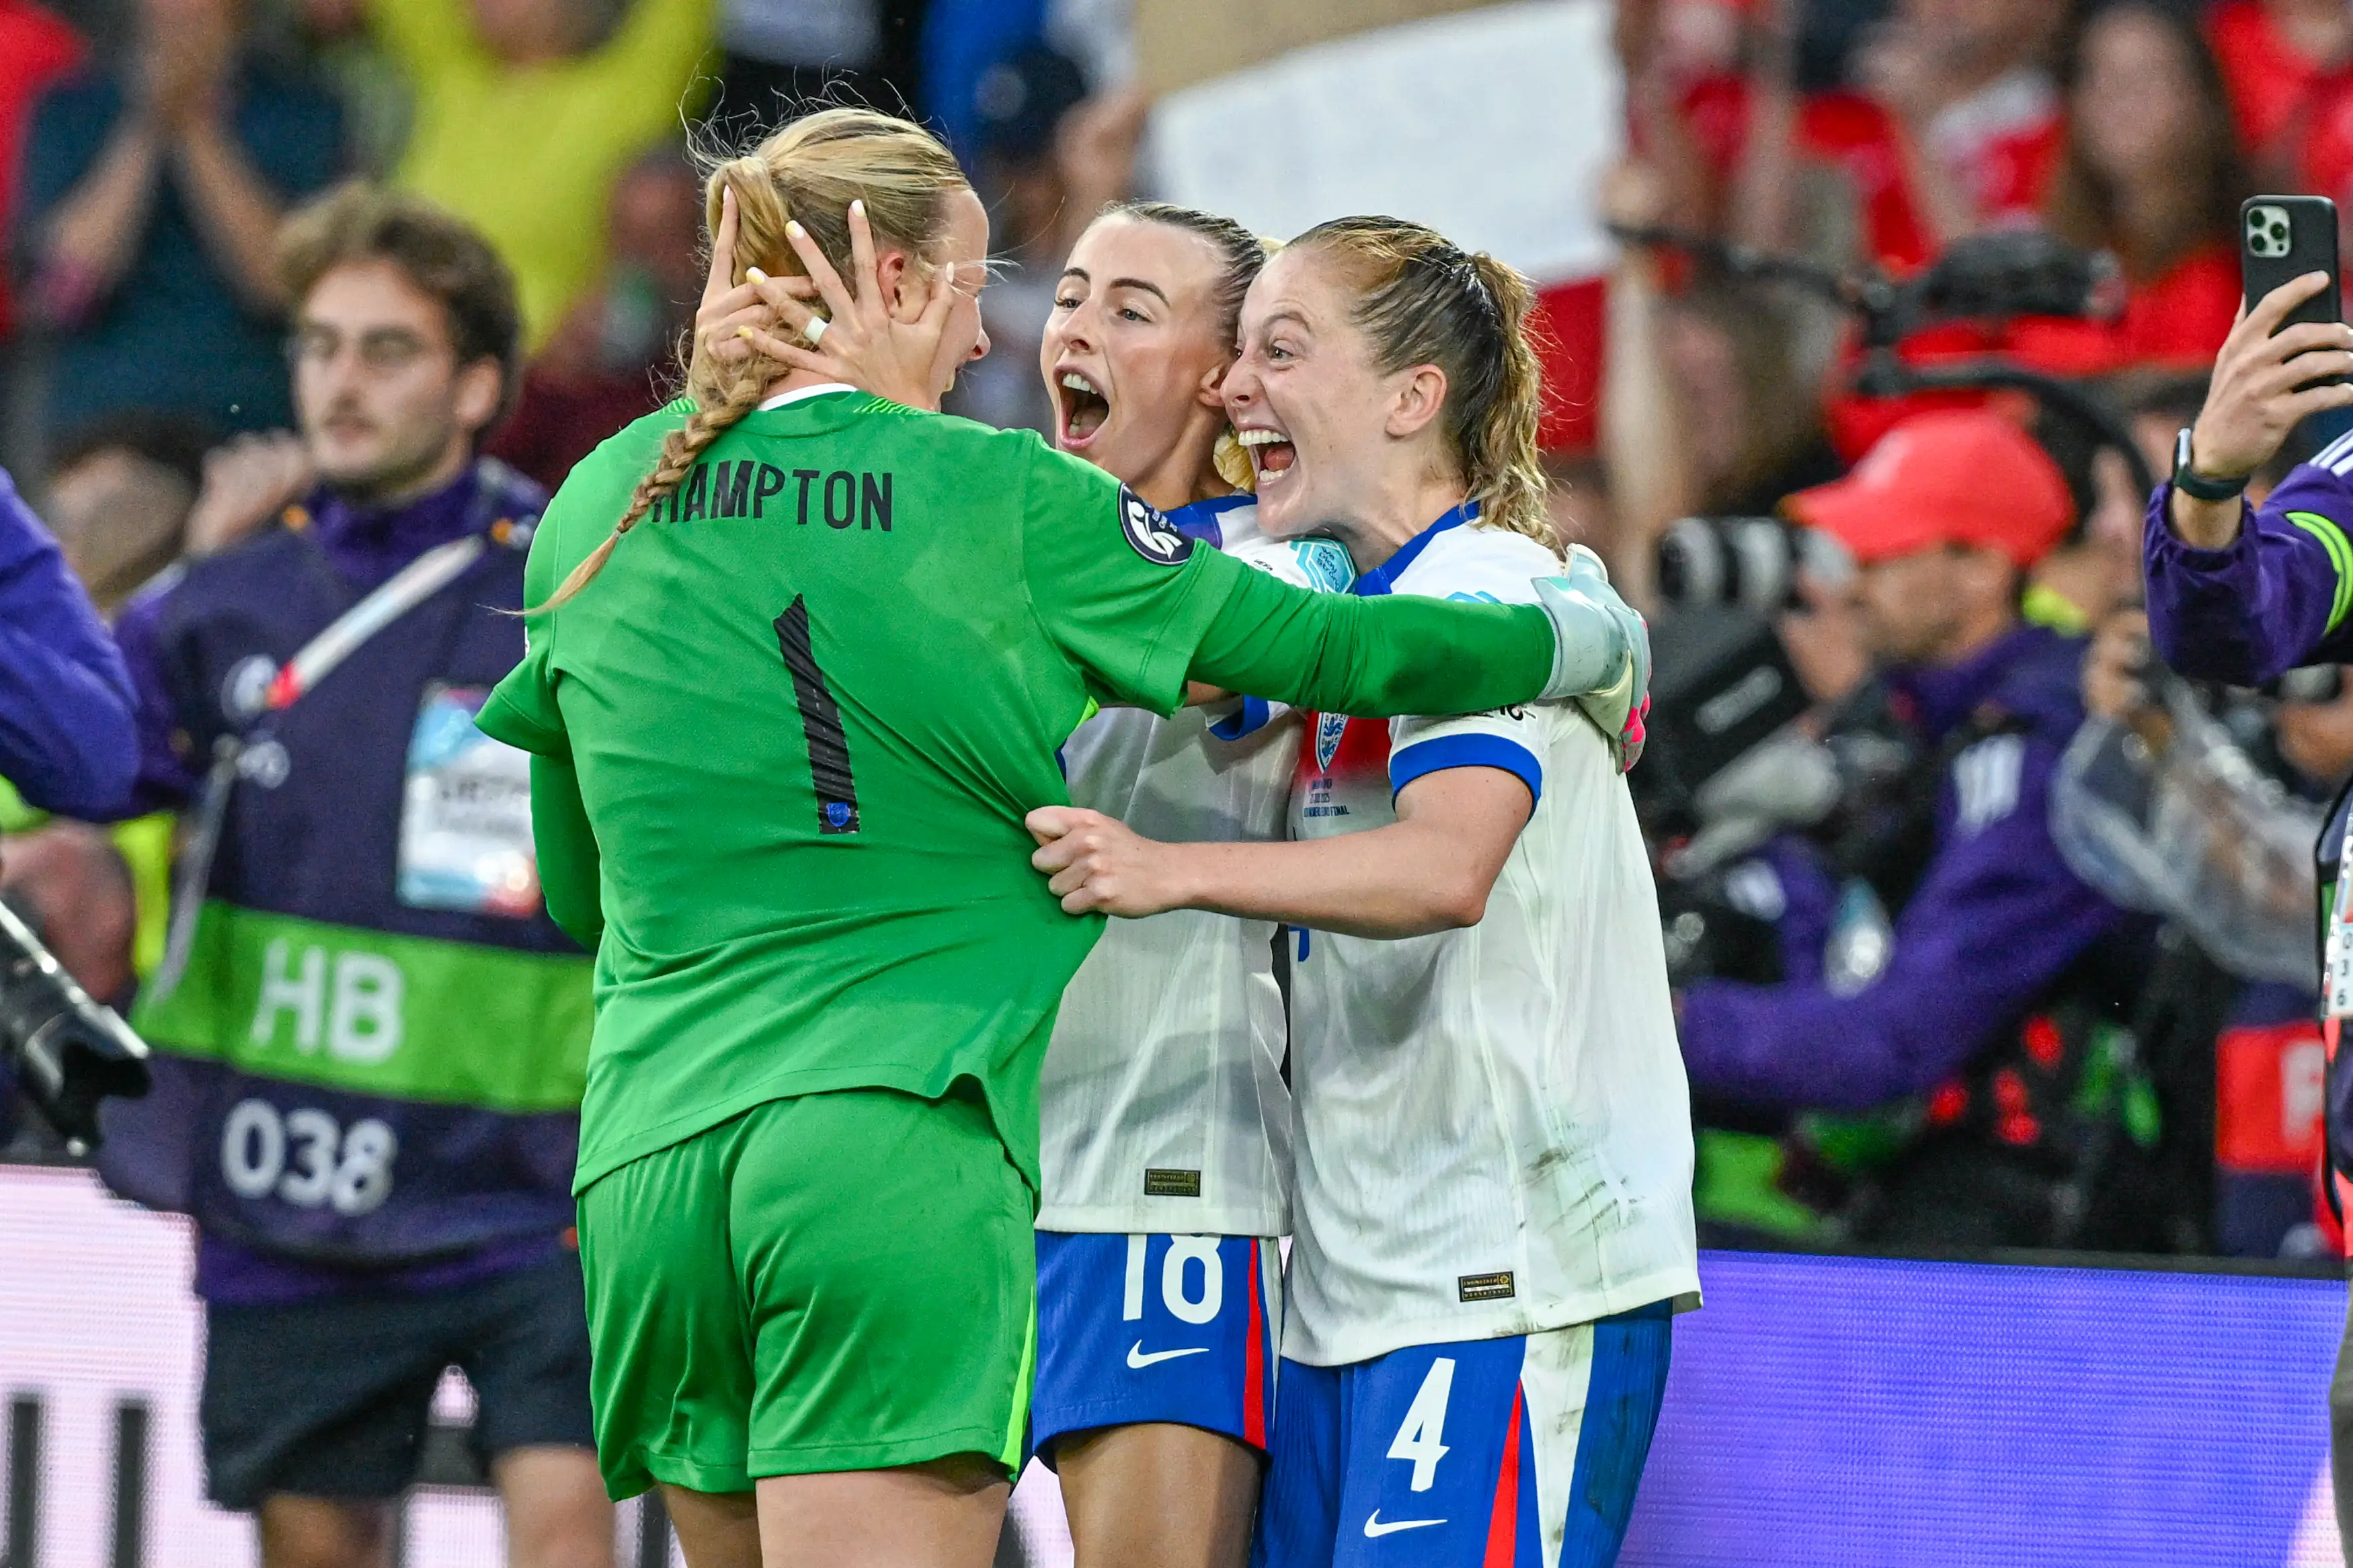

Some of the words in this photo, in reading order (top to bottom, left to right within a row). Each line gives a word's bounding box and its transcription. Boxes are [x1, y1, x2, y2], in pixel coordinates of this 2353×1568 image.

[773, 593, 861, 835] 1
[249, 938, 403, 1061] HB
[223, 1100, 395, 1214] 038
[1123, 1233, 1223, 1324] 18
[1386, 1357, 1455, 1492] 4
